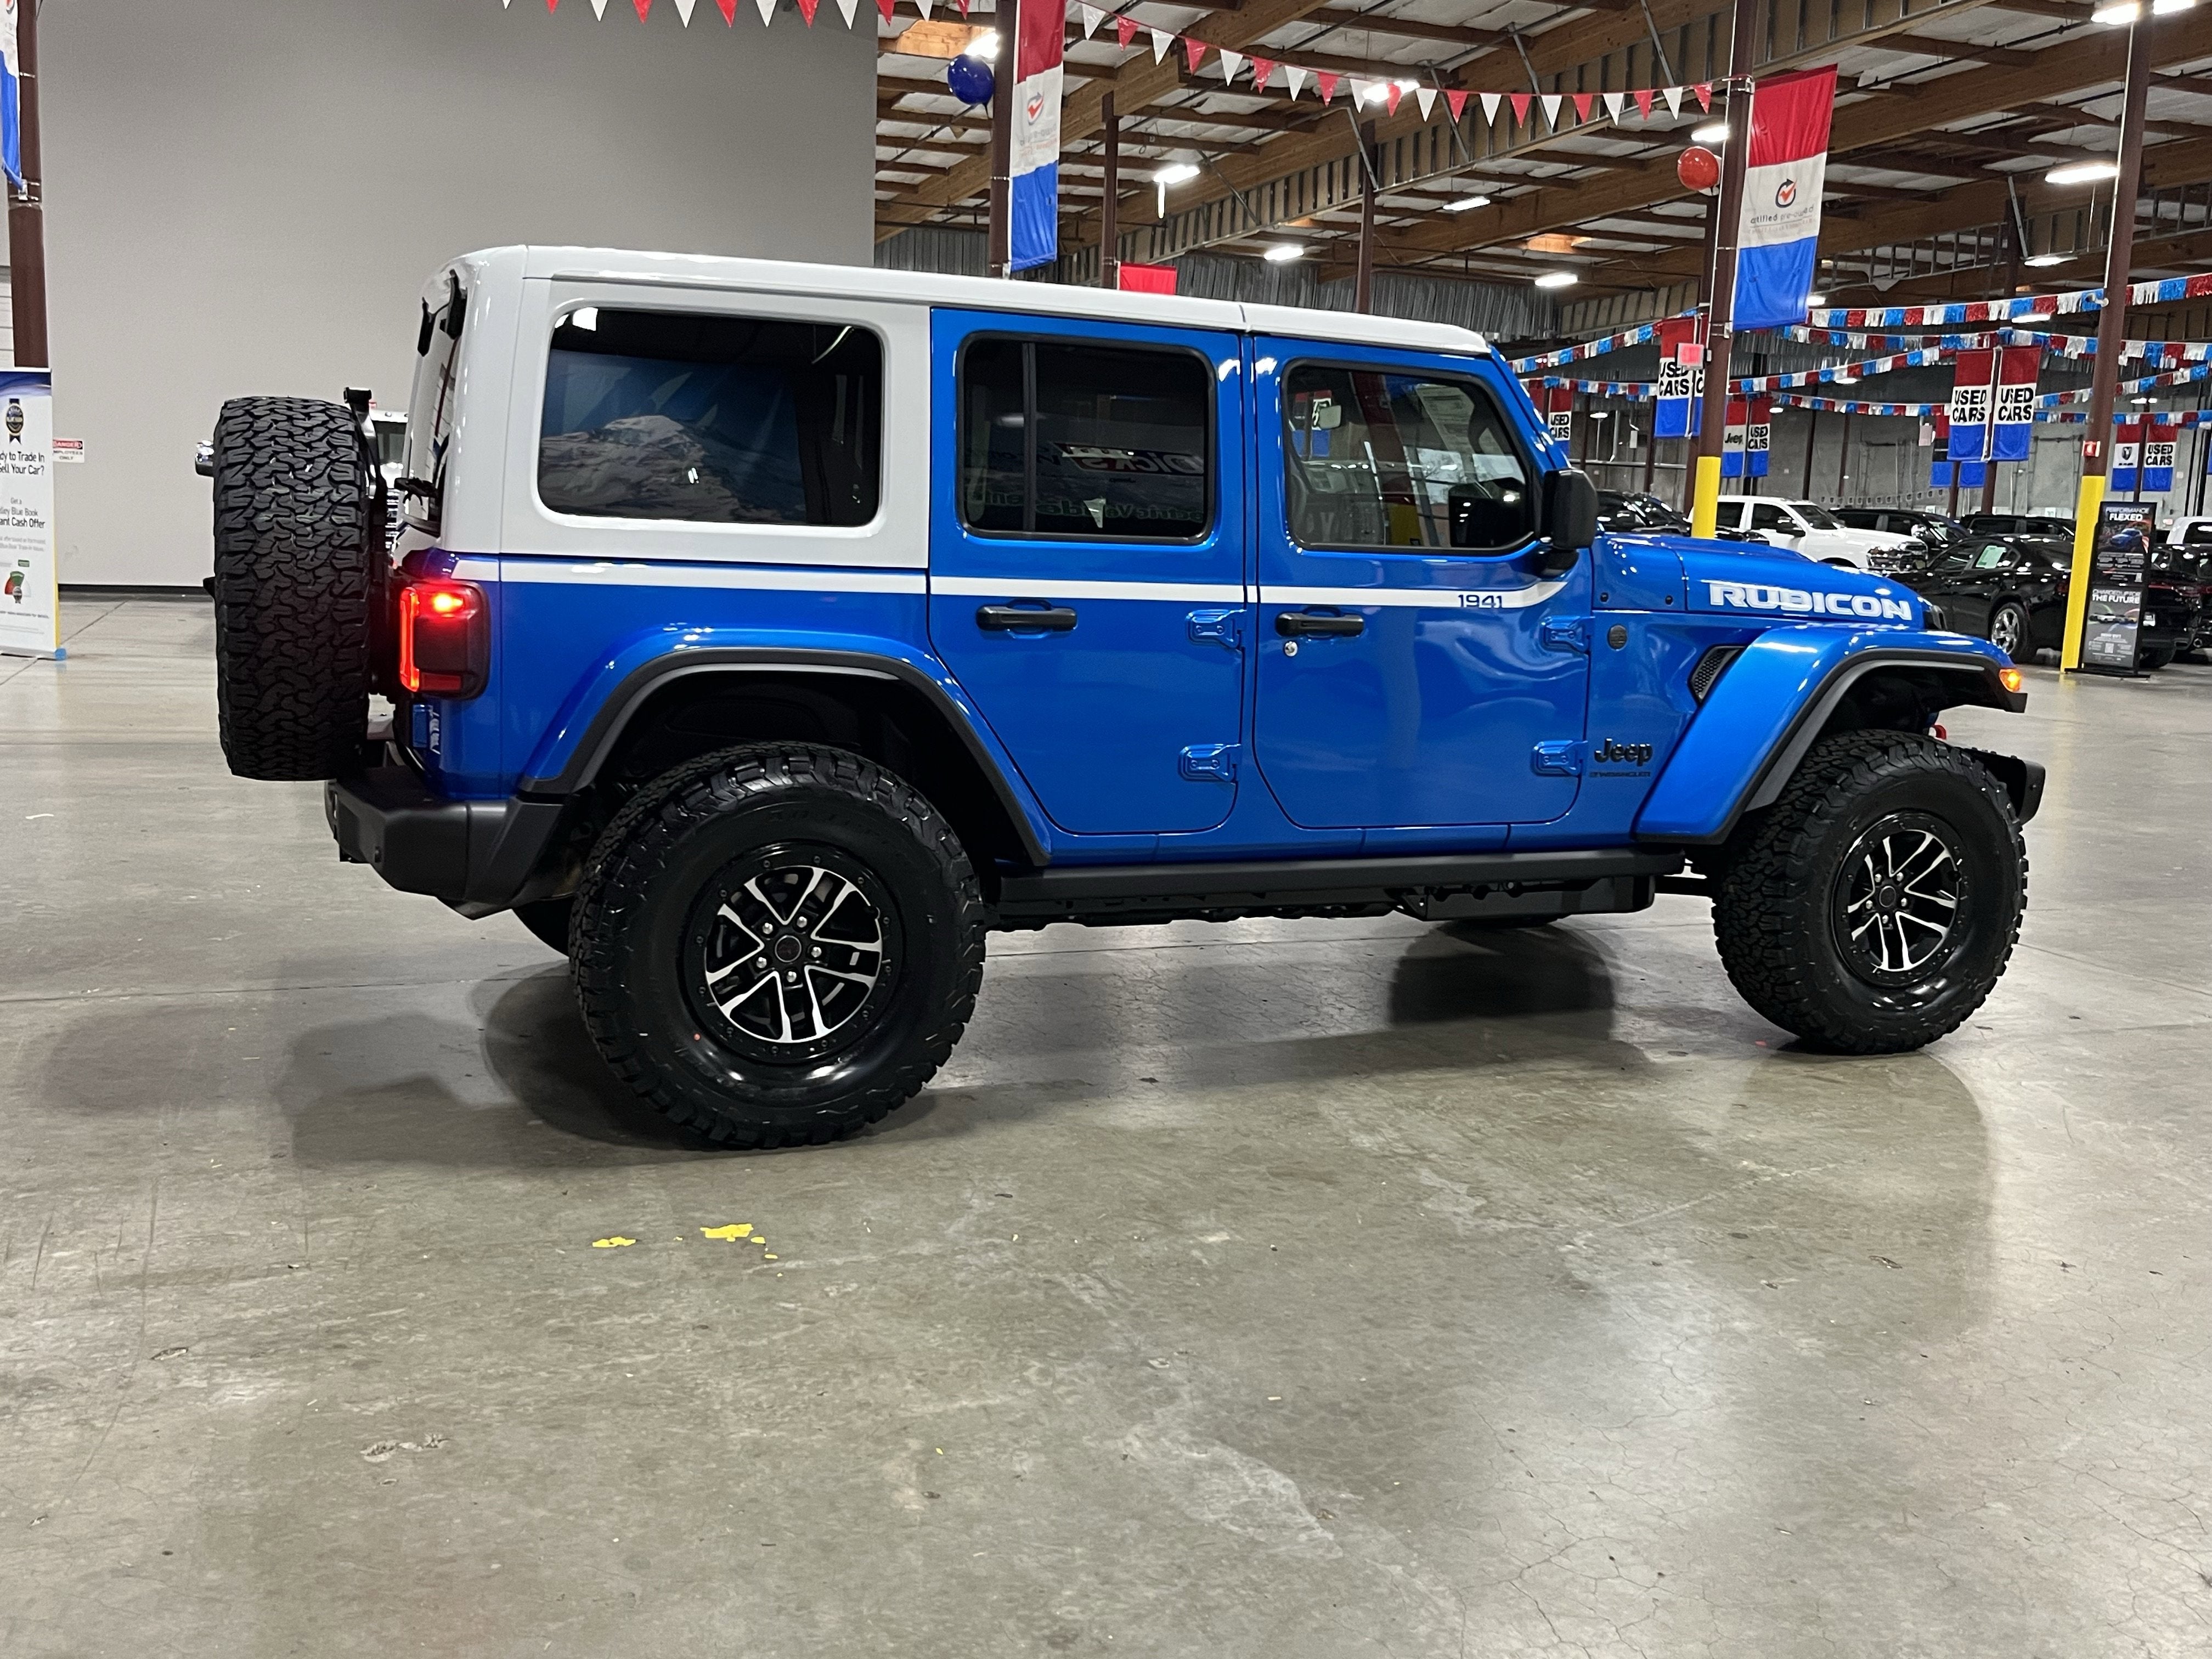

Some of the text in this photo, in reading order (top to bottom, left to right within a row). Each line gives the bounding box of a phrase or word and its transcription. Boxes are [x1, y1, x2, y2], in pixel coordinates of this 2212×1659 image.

[1660, 362, 1690, 378] USE
[1954, 389, 1987, 405] USED
[1953, 406, 1985, 422] CARS
[2148, 444, 2173, 455] USED
[9, 452, 16, 461] to
[18, 451, 37, 462] Trade
[38, 452, 45, 462] In
[2146, 455, 2172, 466] CARS
[10, 463, 27, 475] Your
[28, 464, 44, 476] Car?
[25, 507, 38, 516] Book
[2109, 513, 2143, 521] FLEXED
[12, 517, 27, 527] Cash
[29, 518, 45, 528] Offer
[1458, 594, 1503, 608] 1941
[1709, 583, 1912, 620] RUBICON
[2092, 594, 2140, 604] THE FUTURE
[1594, 738, 1653, 767] Jeep
